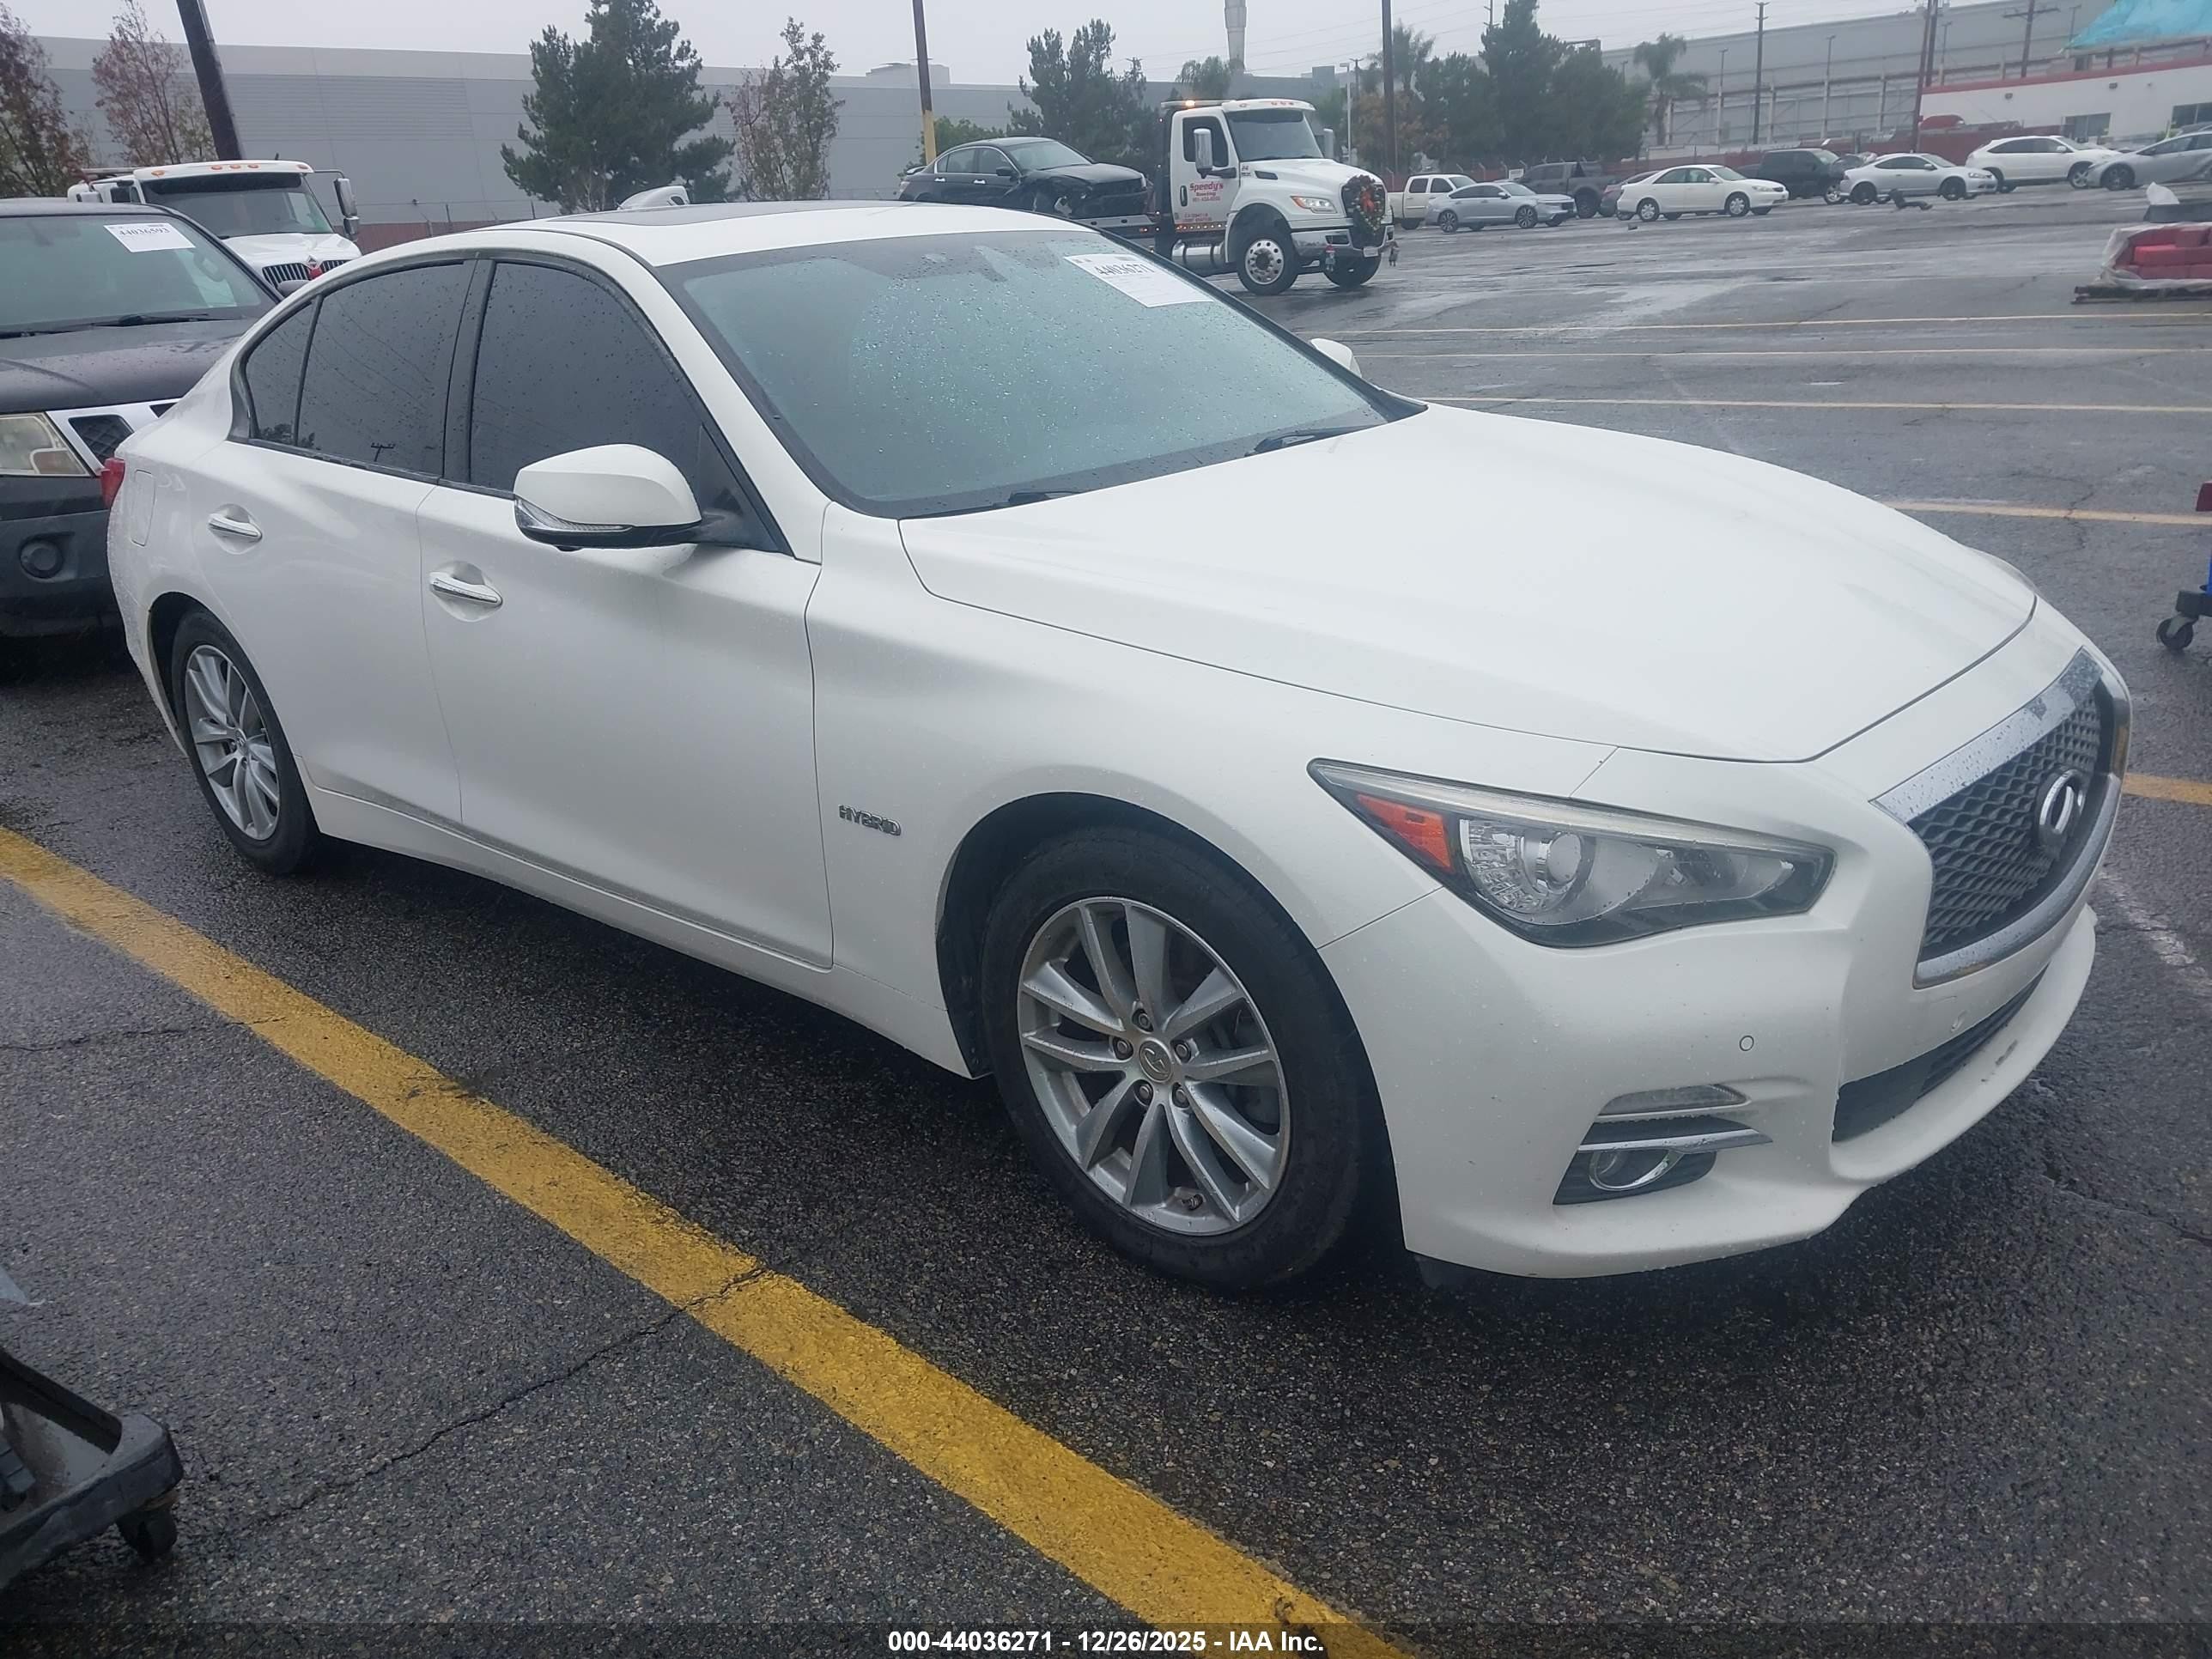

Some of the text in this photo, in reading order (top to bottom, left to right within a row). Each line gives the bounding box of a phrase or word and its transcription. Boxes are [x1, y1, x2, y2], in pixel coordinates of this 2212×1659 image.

[1188, 181, 1223, 192] Speedy's
[1095, 264, 1154, 276] 44036271
[838, 804, 902, 836] HYBRID
